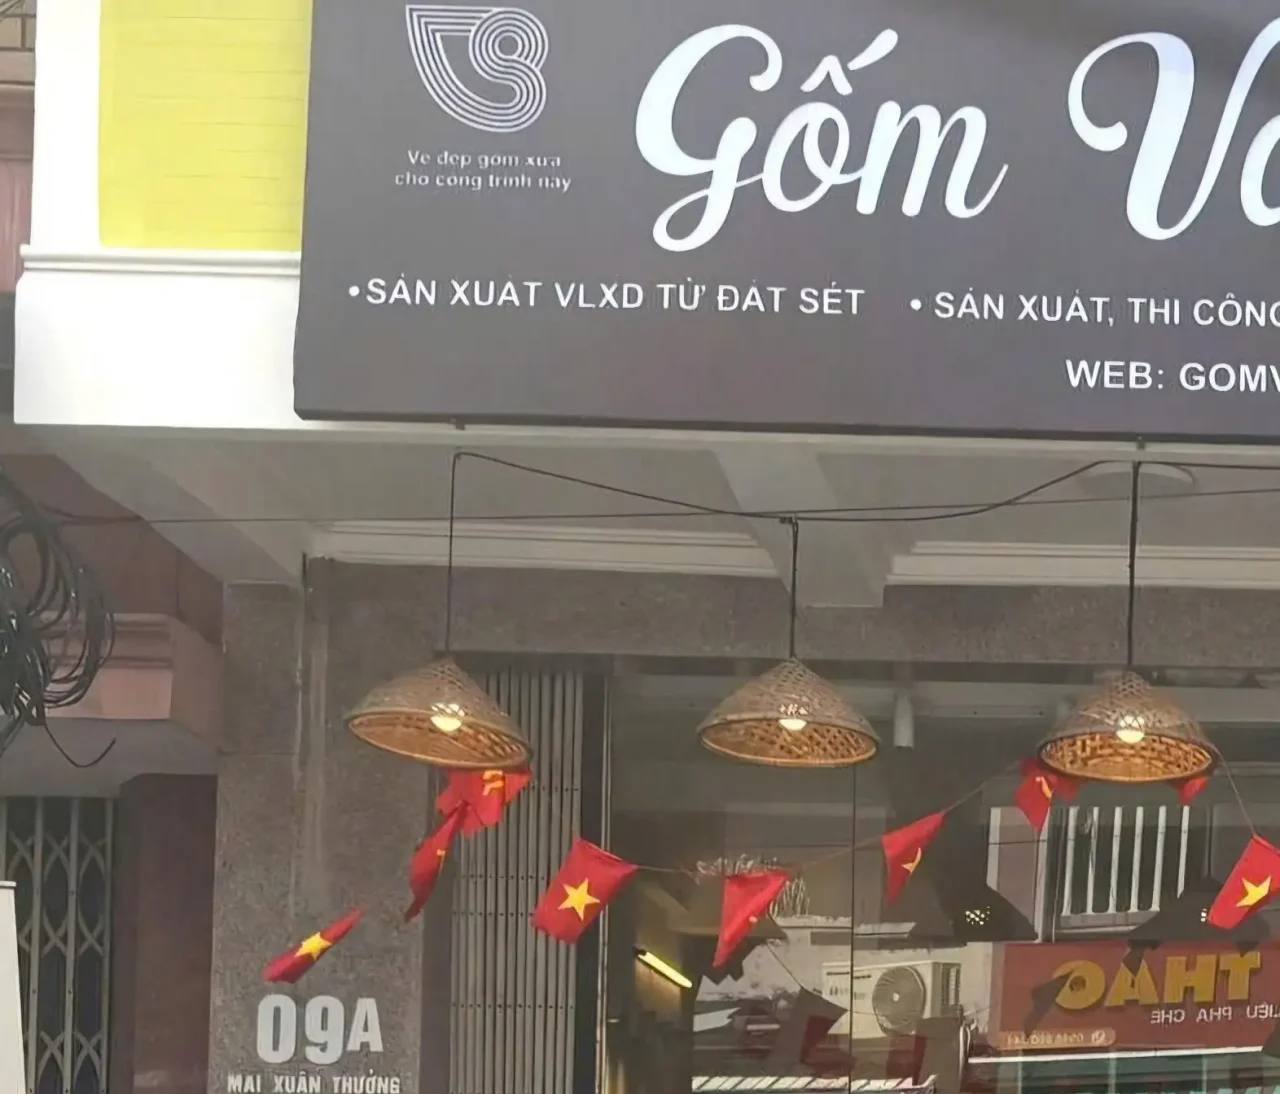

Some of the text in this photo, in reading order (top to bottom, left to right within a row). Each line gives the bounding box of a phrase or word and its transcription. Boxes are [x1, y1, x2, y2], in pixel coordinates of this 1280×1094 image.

[636, 23, 1009, 253] Gốm
[554, 281, 645, 309] VLXD
[1126, 297, 1180, 325] THI
[1065, 359, 1165, 390] WEB:
[257, 994, 383, 1065] 09A
[227, 1074, 262, 1094] MAI
[273, 1071, 322, 1094] XUÂN
